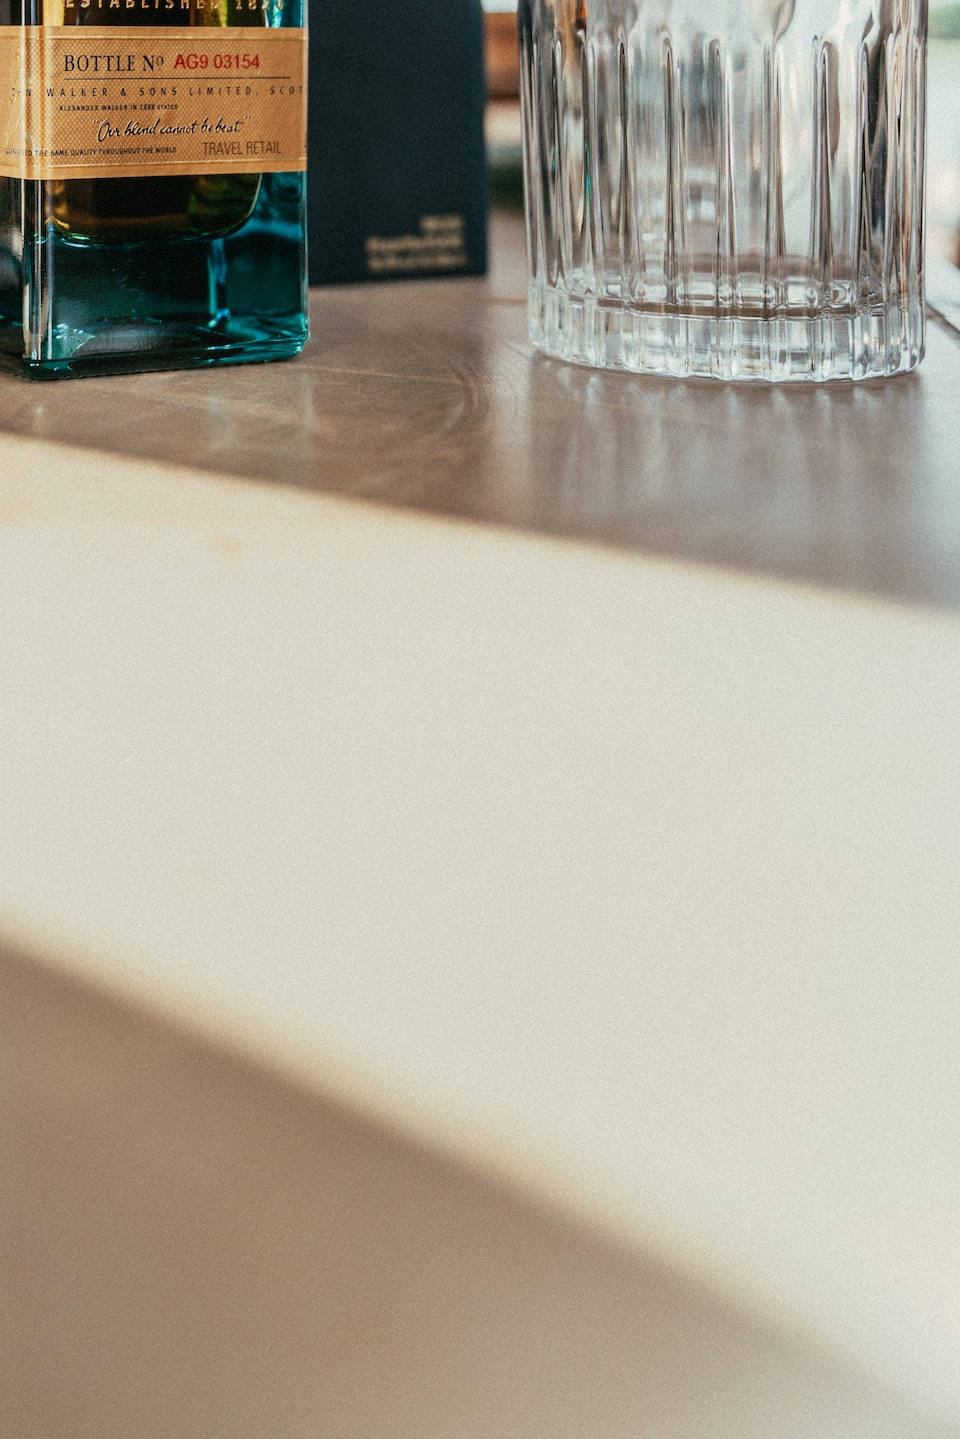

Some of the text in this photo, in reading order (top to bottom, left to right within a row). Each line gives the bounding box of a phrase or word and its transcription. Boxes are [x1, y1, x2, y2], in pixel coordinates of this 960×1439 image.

[64, 55, 135, 72] BOTTLE
[174, 53, 208, 70] AG9
[214, 53, 260, 69] 03154
[47, 87, 108, 97] WALKER
[120, 87, 126, 97] &
[139, 87, 177, 97] SONS
[189, 86, 259, 97] LIMITED,
[59, 104, 99, 112] ALEXANDER
[123, 118, 160, 137] blend
[160, 122, 198, 135] cannot
[200, 116, 213, 134] be
[51, 148, 69, 157] SAME
[71, 148, 96, 157] QUALITY
[99, 146, 141, 156] THROUGHOUT
[143, 146, 153, 154] THE
[203, 140, 282, 157] TRAVEL RETAIL
